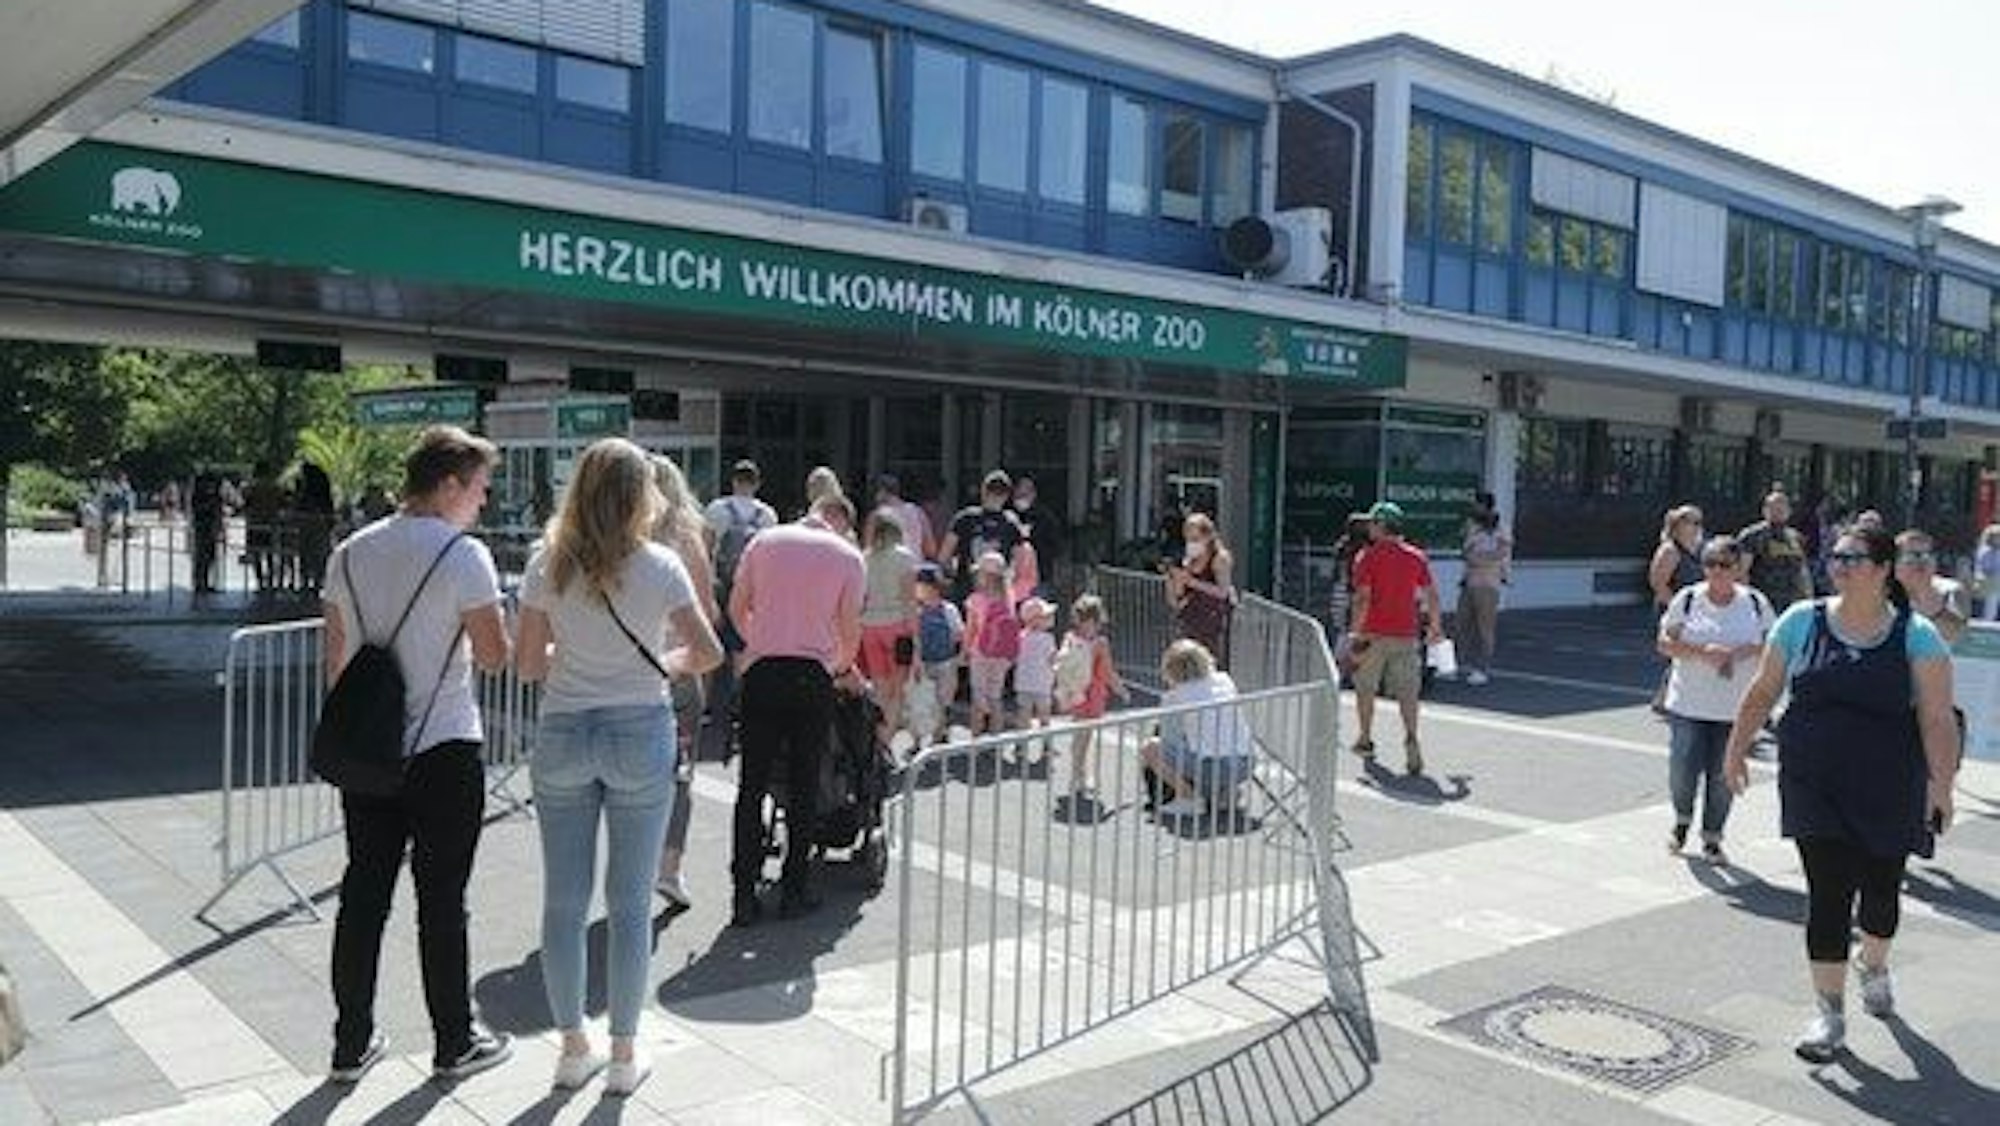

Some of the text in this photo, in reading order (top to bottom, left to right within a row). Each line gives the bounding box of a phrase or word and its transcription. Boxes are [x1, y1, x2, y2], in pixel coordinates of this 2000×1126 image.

[88, 213, 203, 239] KÖLNER ZOO
[519, 231, 1206, 350] HERZLICH WILLKOMMEN IM KÖLNER ZOO
